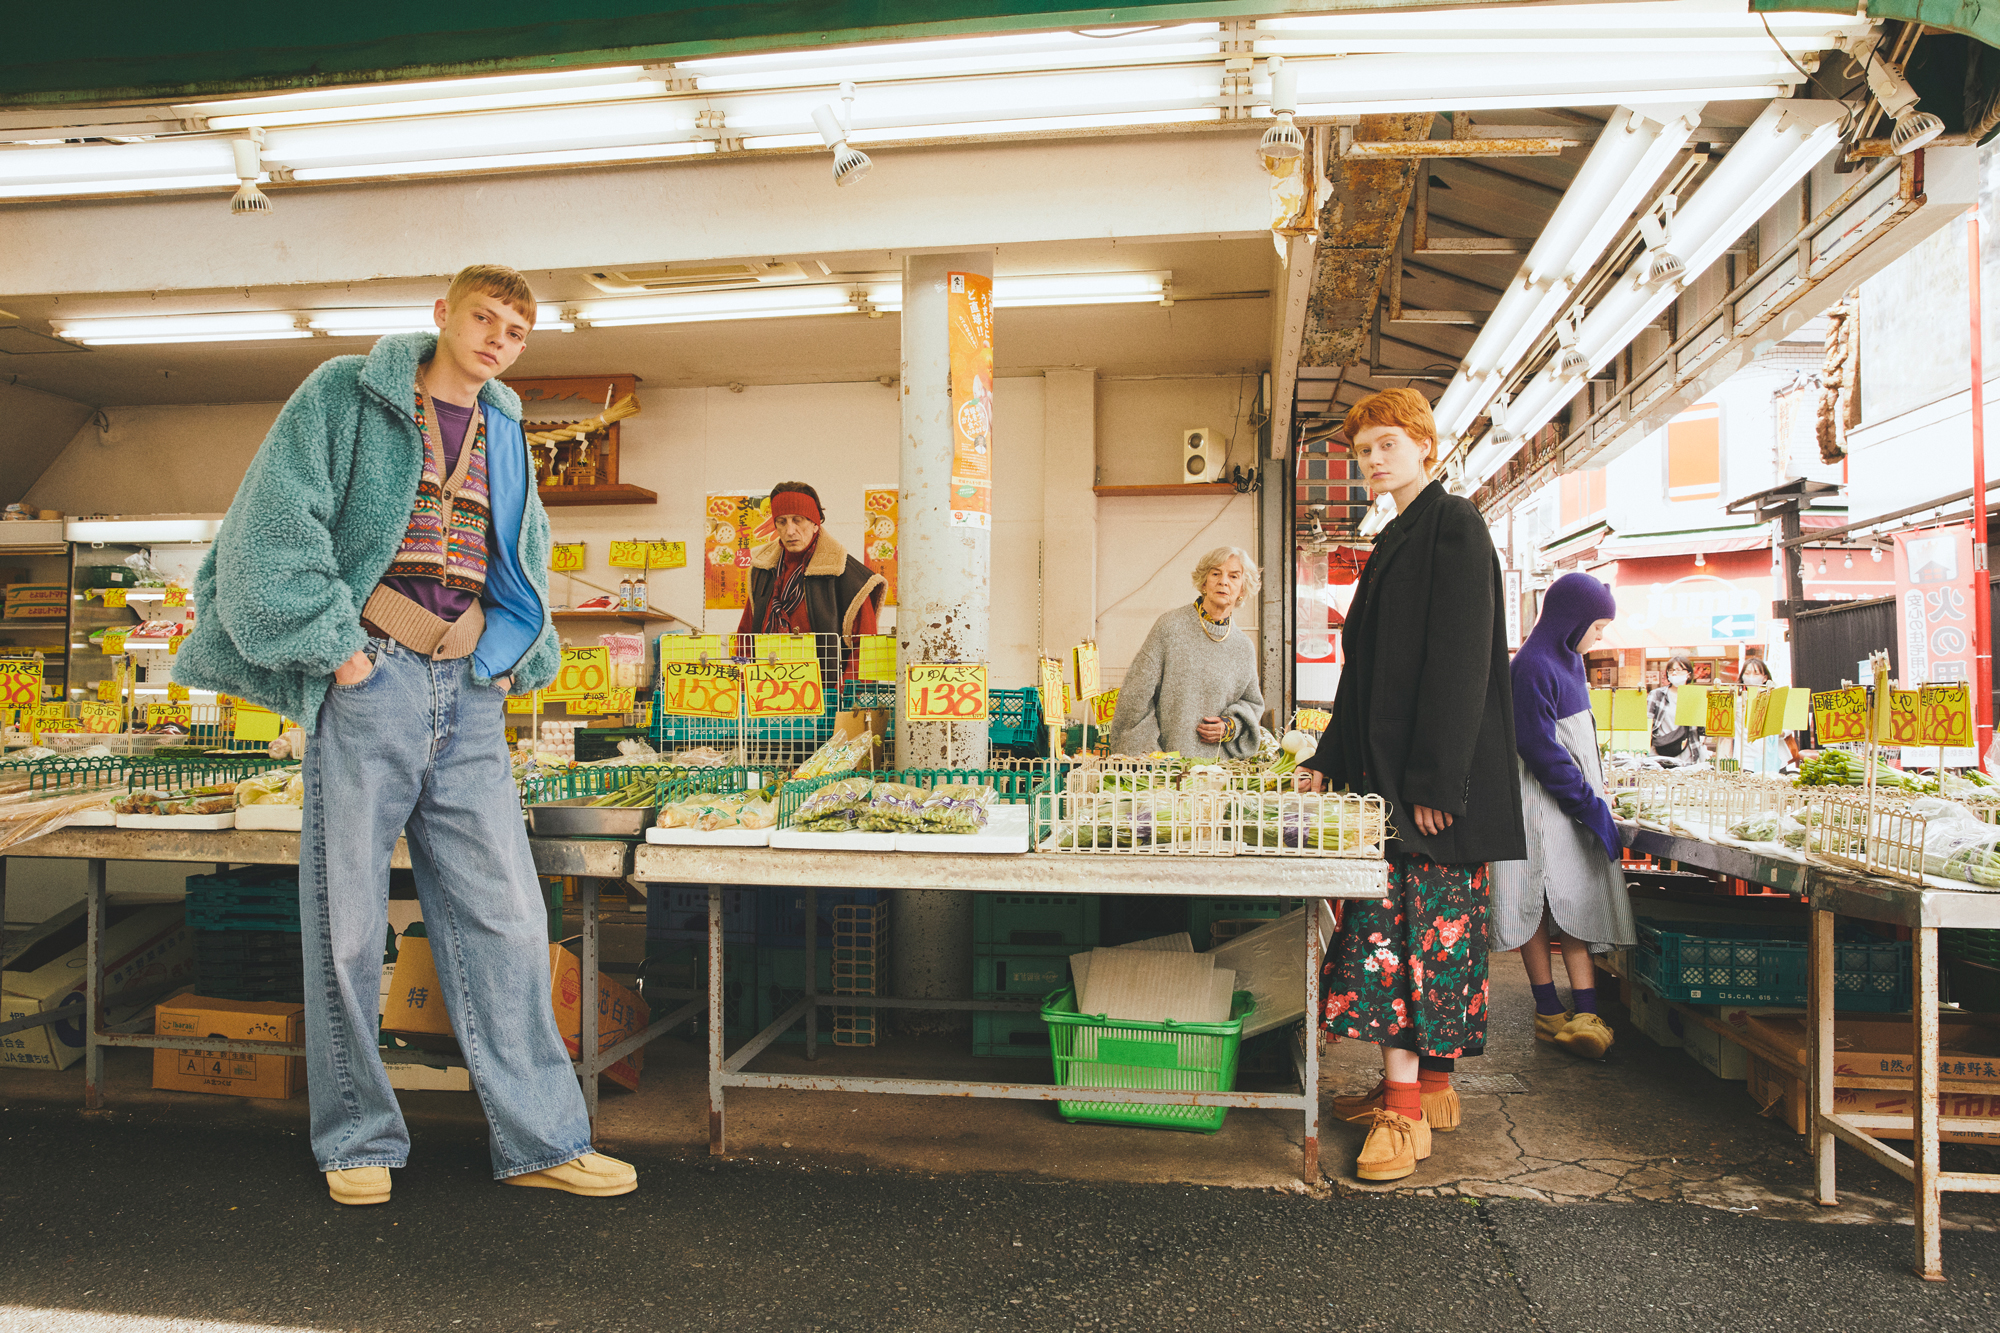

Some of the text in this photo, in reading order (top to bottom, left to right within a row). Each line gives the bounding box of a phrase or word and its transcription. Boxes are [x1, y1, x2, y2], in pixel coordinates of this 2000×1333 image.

[911, 682, 983, 717] ¥138
[406, 986, 429, 1009] 特
[187, 1059, 196, 1071] A
[212, 1061, 222, 1074] 4
